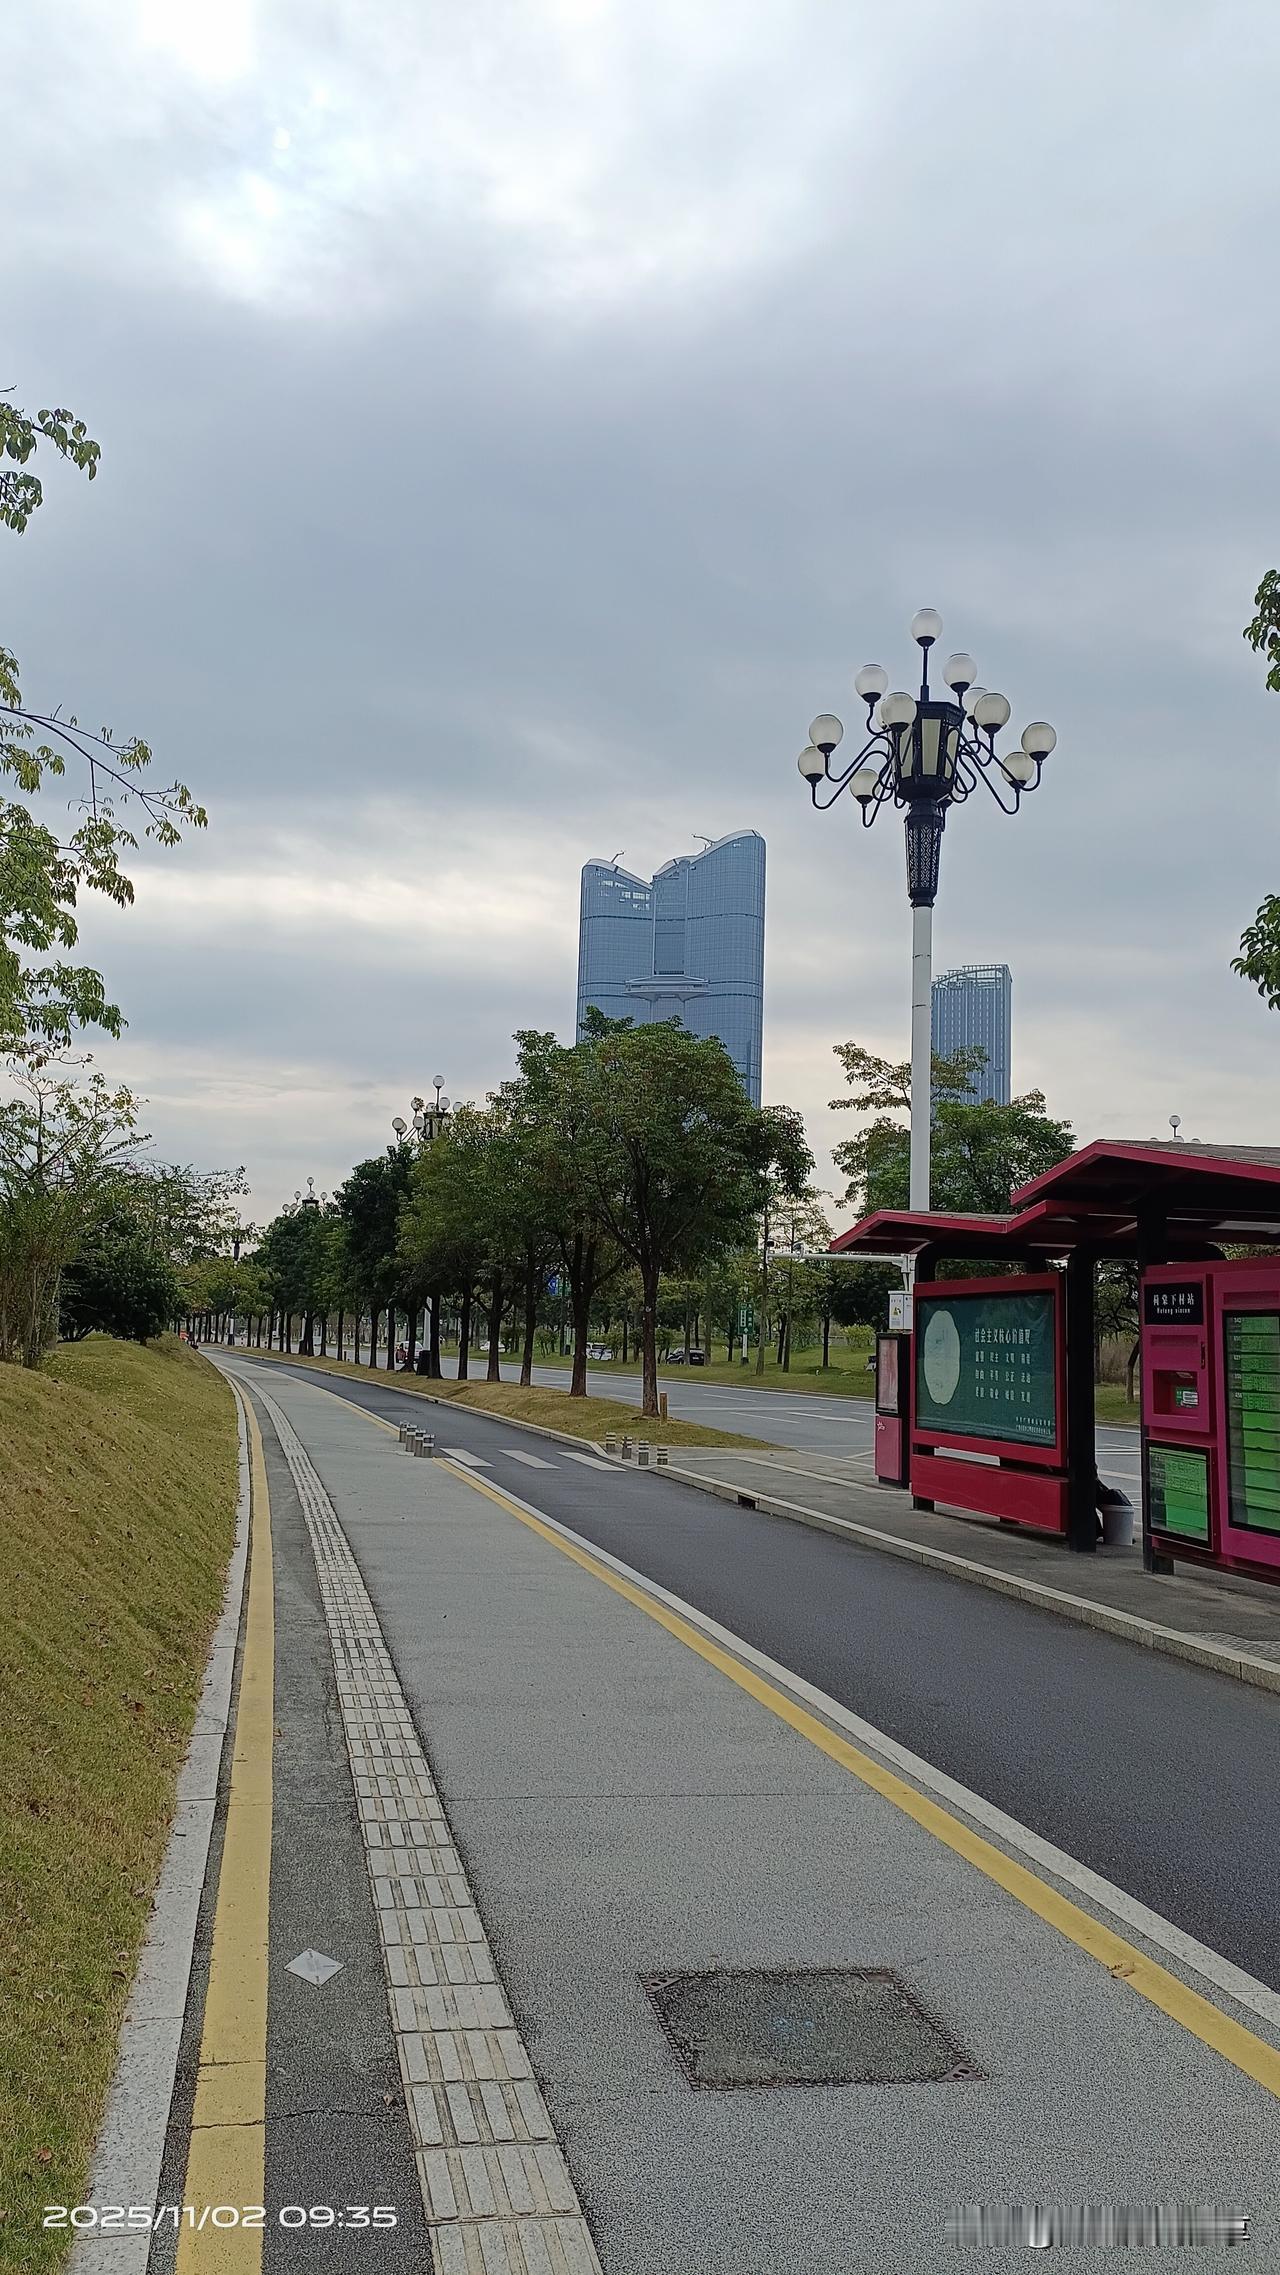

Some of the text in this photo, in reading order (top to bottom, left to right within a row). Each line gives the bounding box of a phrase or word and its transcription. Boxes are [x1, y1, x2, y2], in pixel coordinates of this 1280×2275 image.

[975, 1328, 1030, 1344] 社会主义核心价值观
